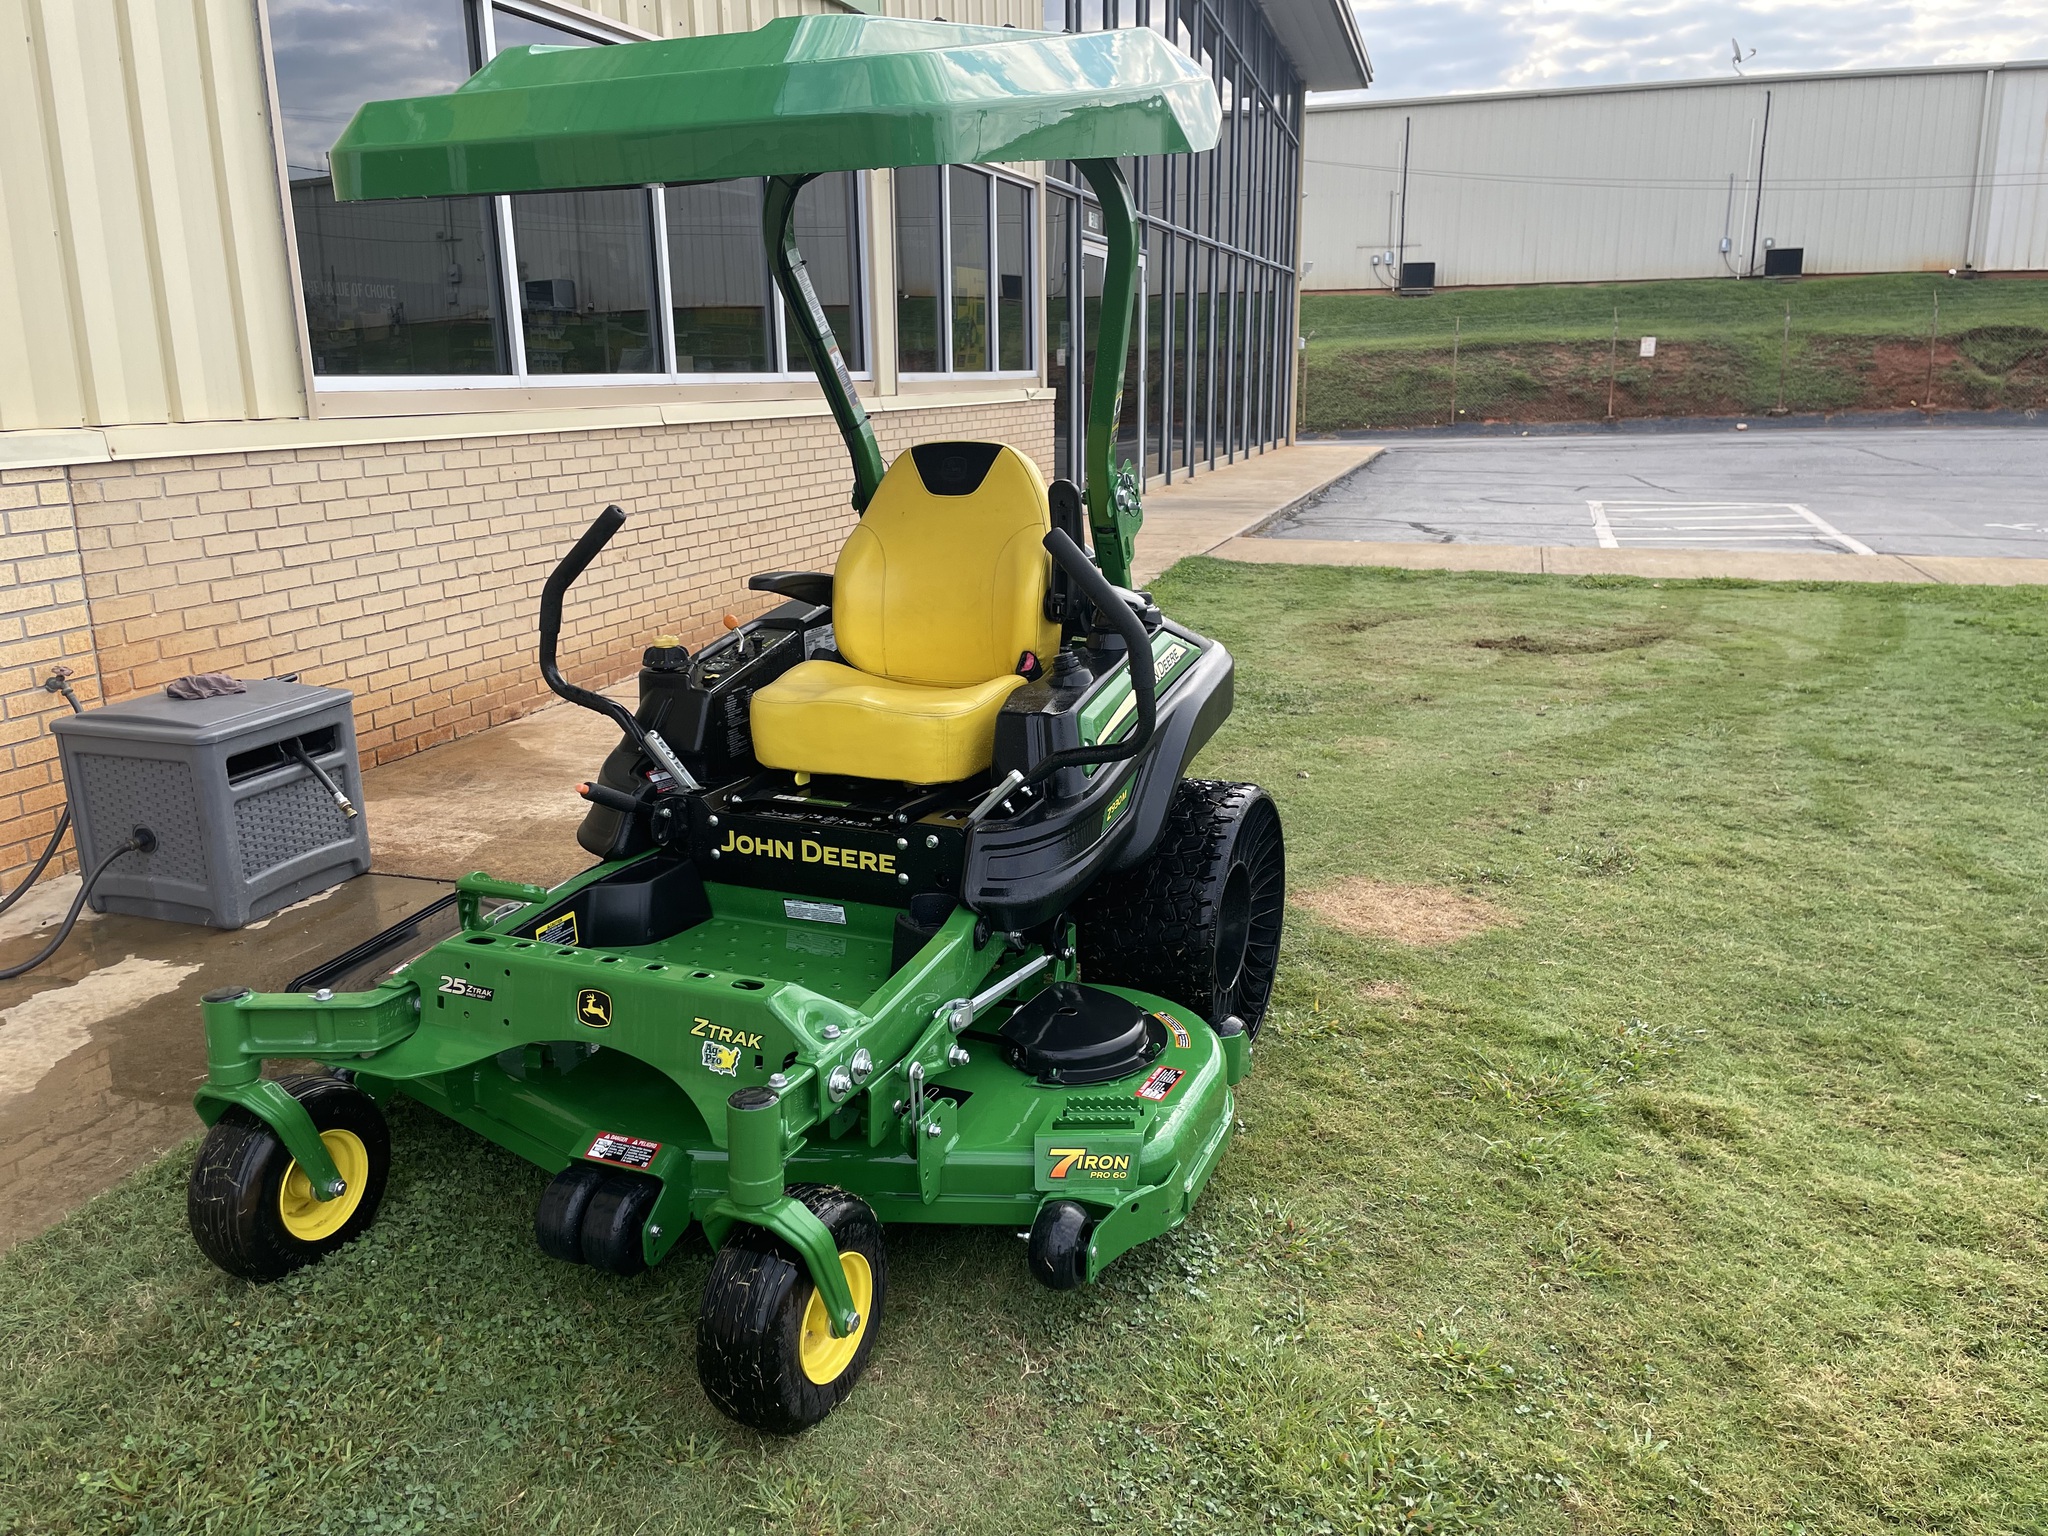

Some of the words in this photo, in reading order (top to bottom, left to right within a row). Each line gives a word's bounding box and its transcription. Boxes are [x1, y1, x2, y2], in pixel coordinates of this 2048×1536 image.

[351, 282, 362, 297] OF
[365, 284, 396, 299] CHOICE
[720, 830, 794, 860] JOHN
[801, 839, 896, 874] DEERE
[438, 975, 467, 995] 25
[466, 984, 493, 997] ZTRAK
[690, 1017, 764, 1050] ZTRAK
[704, 1043, 722, 1057] Ag-
[704, 1053, 722, 1065] Pro
[609, 1134, 629, 1143] DANGER
[1048, 1148, 1087, 1178] 7
[1076, 1155, 1130, 1170] IRON
[1089, 1171, 1111, 1179] PRO
[1112, 1171, 1127, 1179] 60
